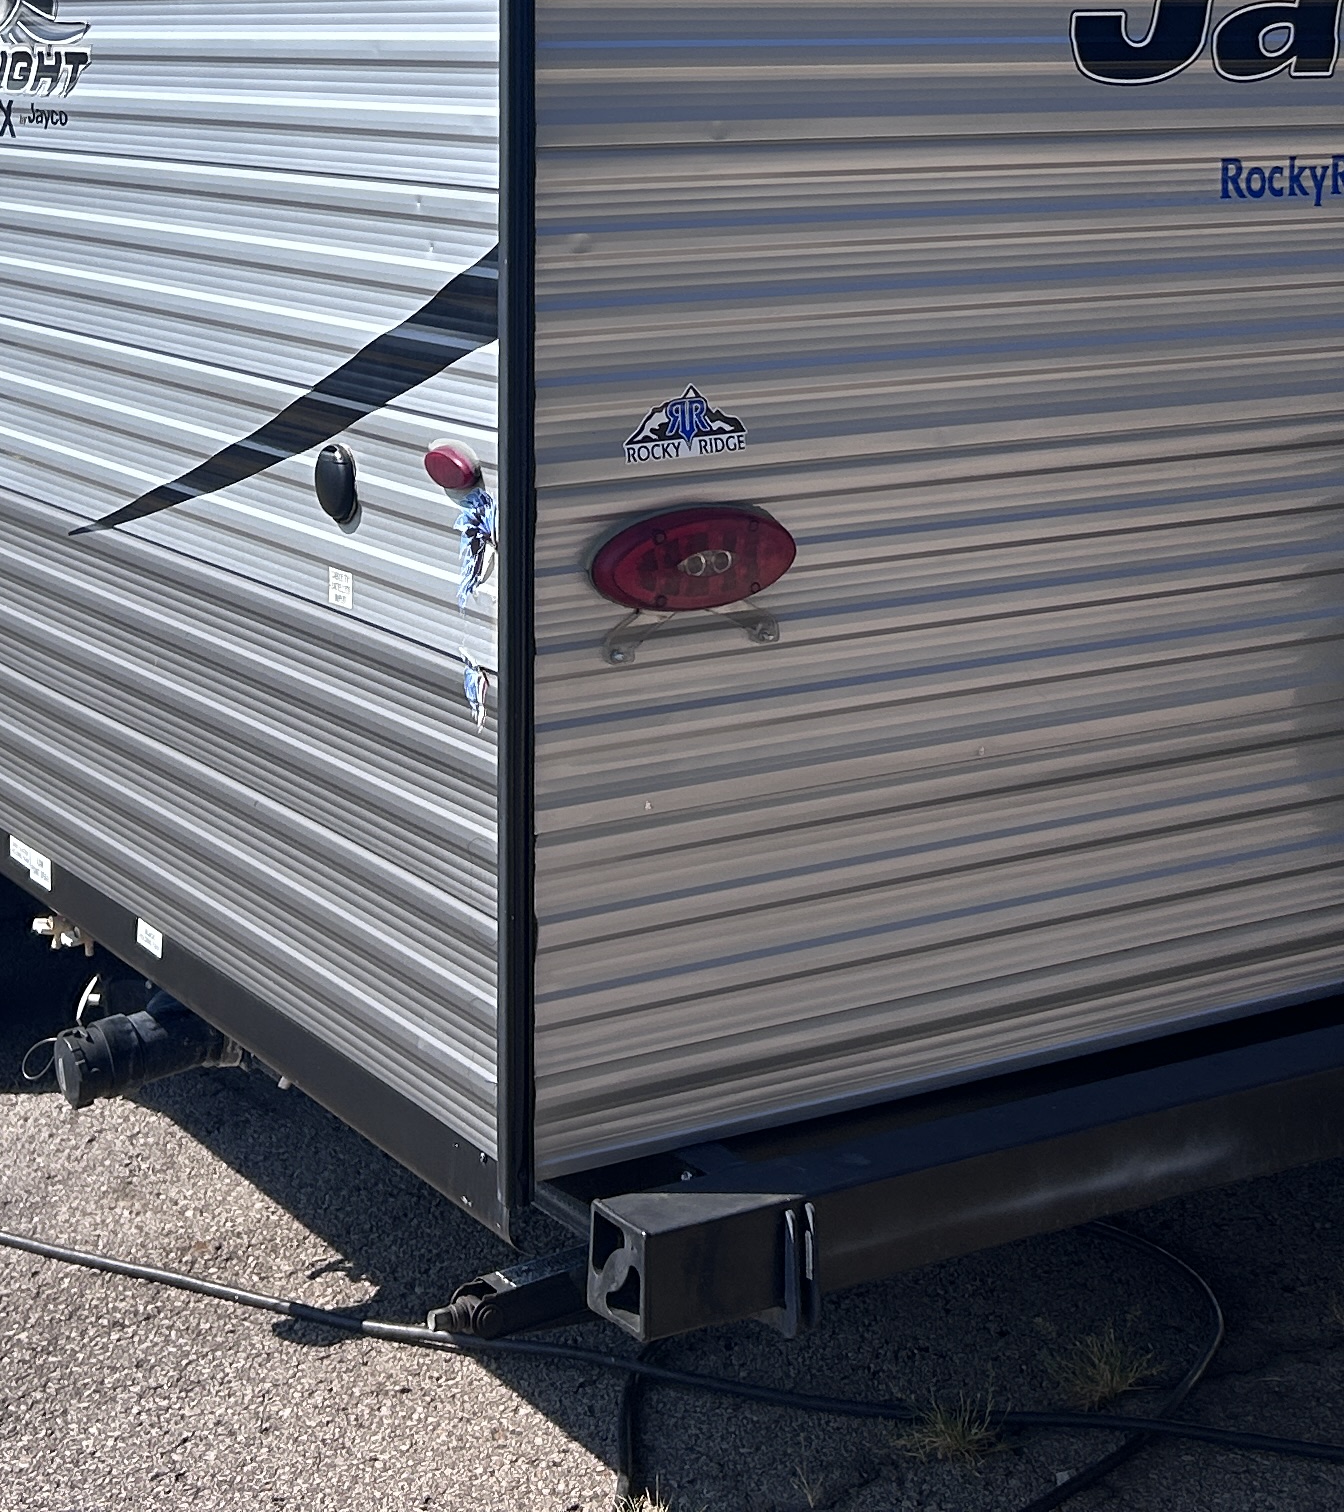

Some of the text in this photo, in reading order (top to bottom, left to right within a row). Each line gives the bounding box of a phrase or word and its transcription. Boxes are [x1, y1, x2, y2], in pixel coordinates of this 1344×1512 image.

[28, 102, 68, 130] Jayco
[627, 434, 746, 464] ROCKY RIDGE
